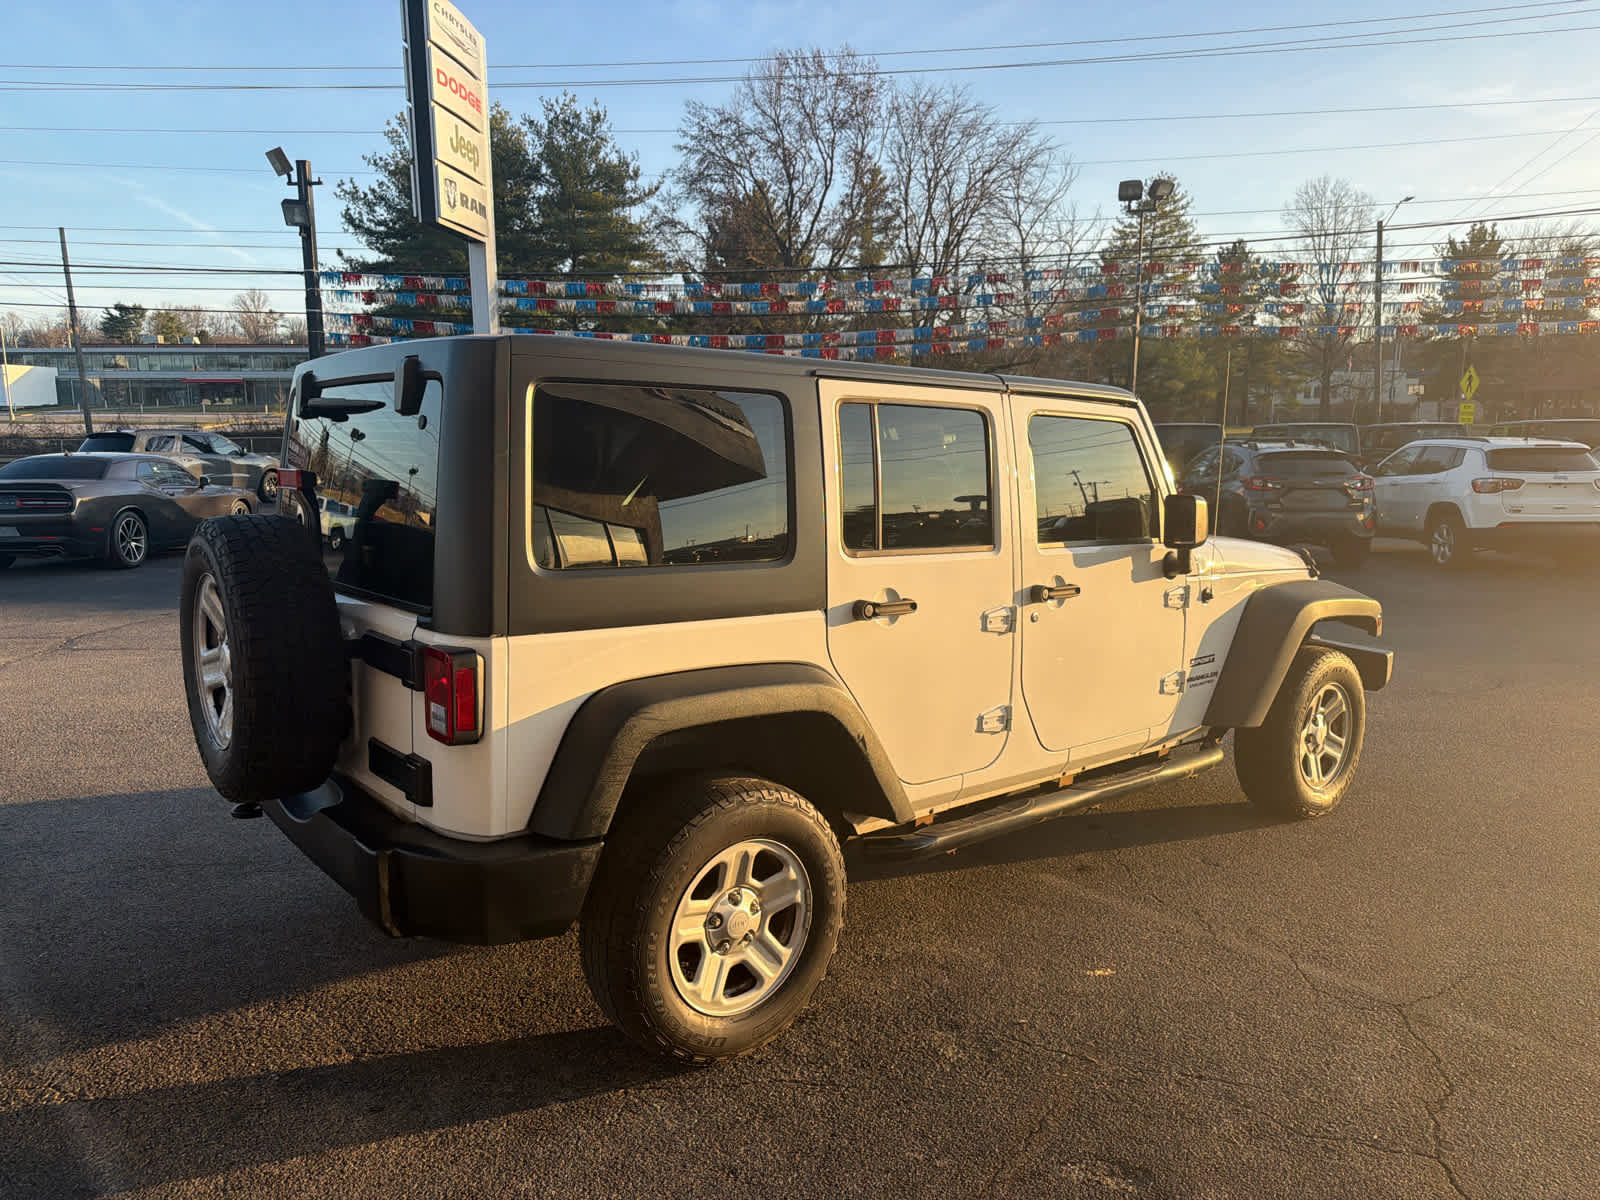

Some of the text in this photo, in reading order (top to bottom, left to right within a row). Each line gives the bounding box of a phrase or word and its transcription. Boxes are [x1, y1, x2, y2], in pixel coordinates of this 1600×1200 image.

[434, 2, 477, 47] CHRYSLER
[436, 68, 482, 115] DODGE
[449, 124, 480, 172] Jeep
[459, 191, 487, 219] RAM
